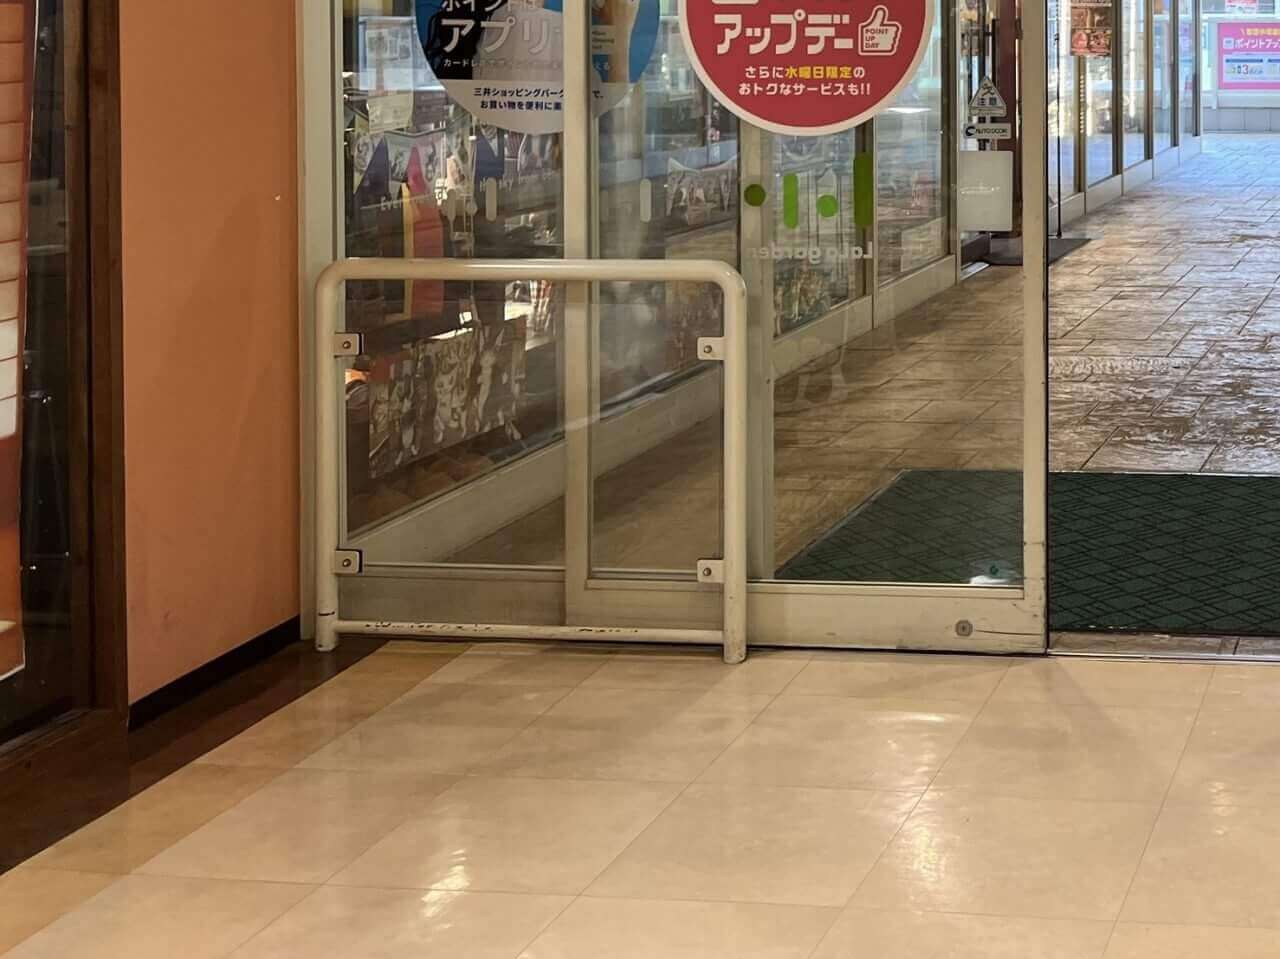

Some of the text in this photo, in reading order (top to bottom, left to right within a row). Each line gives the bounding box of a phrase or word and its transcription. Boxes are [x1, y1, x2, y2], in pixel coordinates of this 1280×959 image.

[441, 16, 562, 54] アプリ
[865, 28, 889, 36] POINT
[745, 66, 865, 79] さらに水曜日限定の
